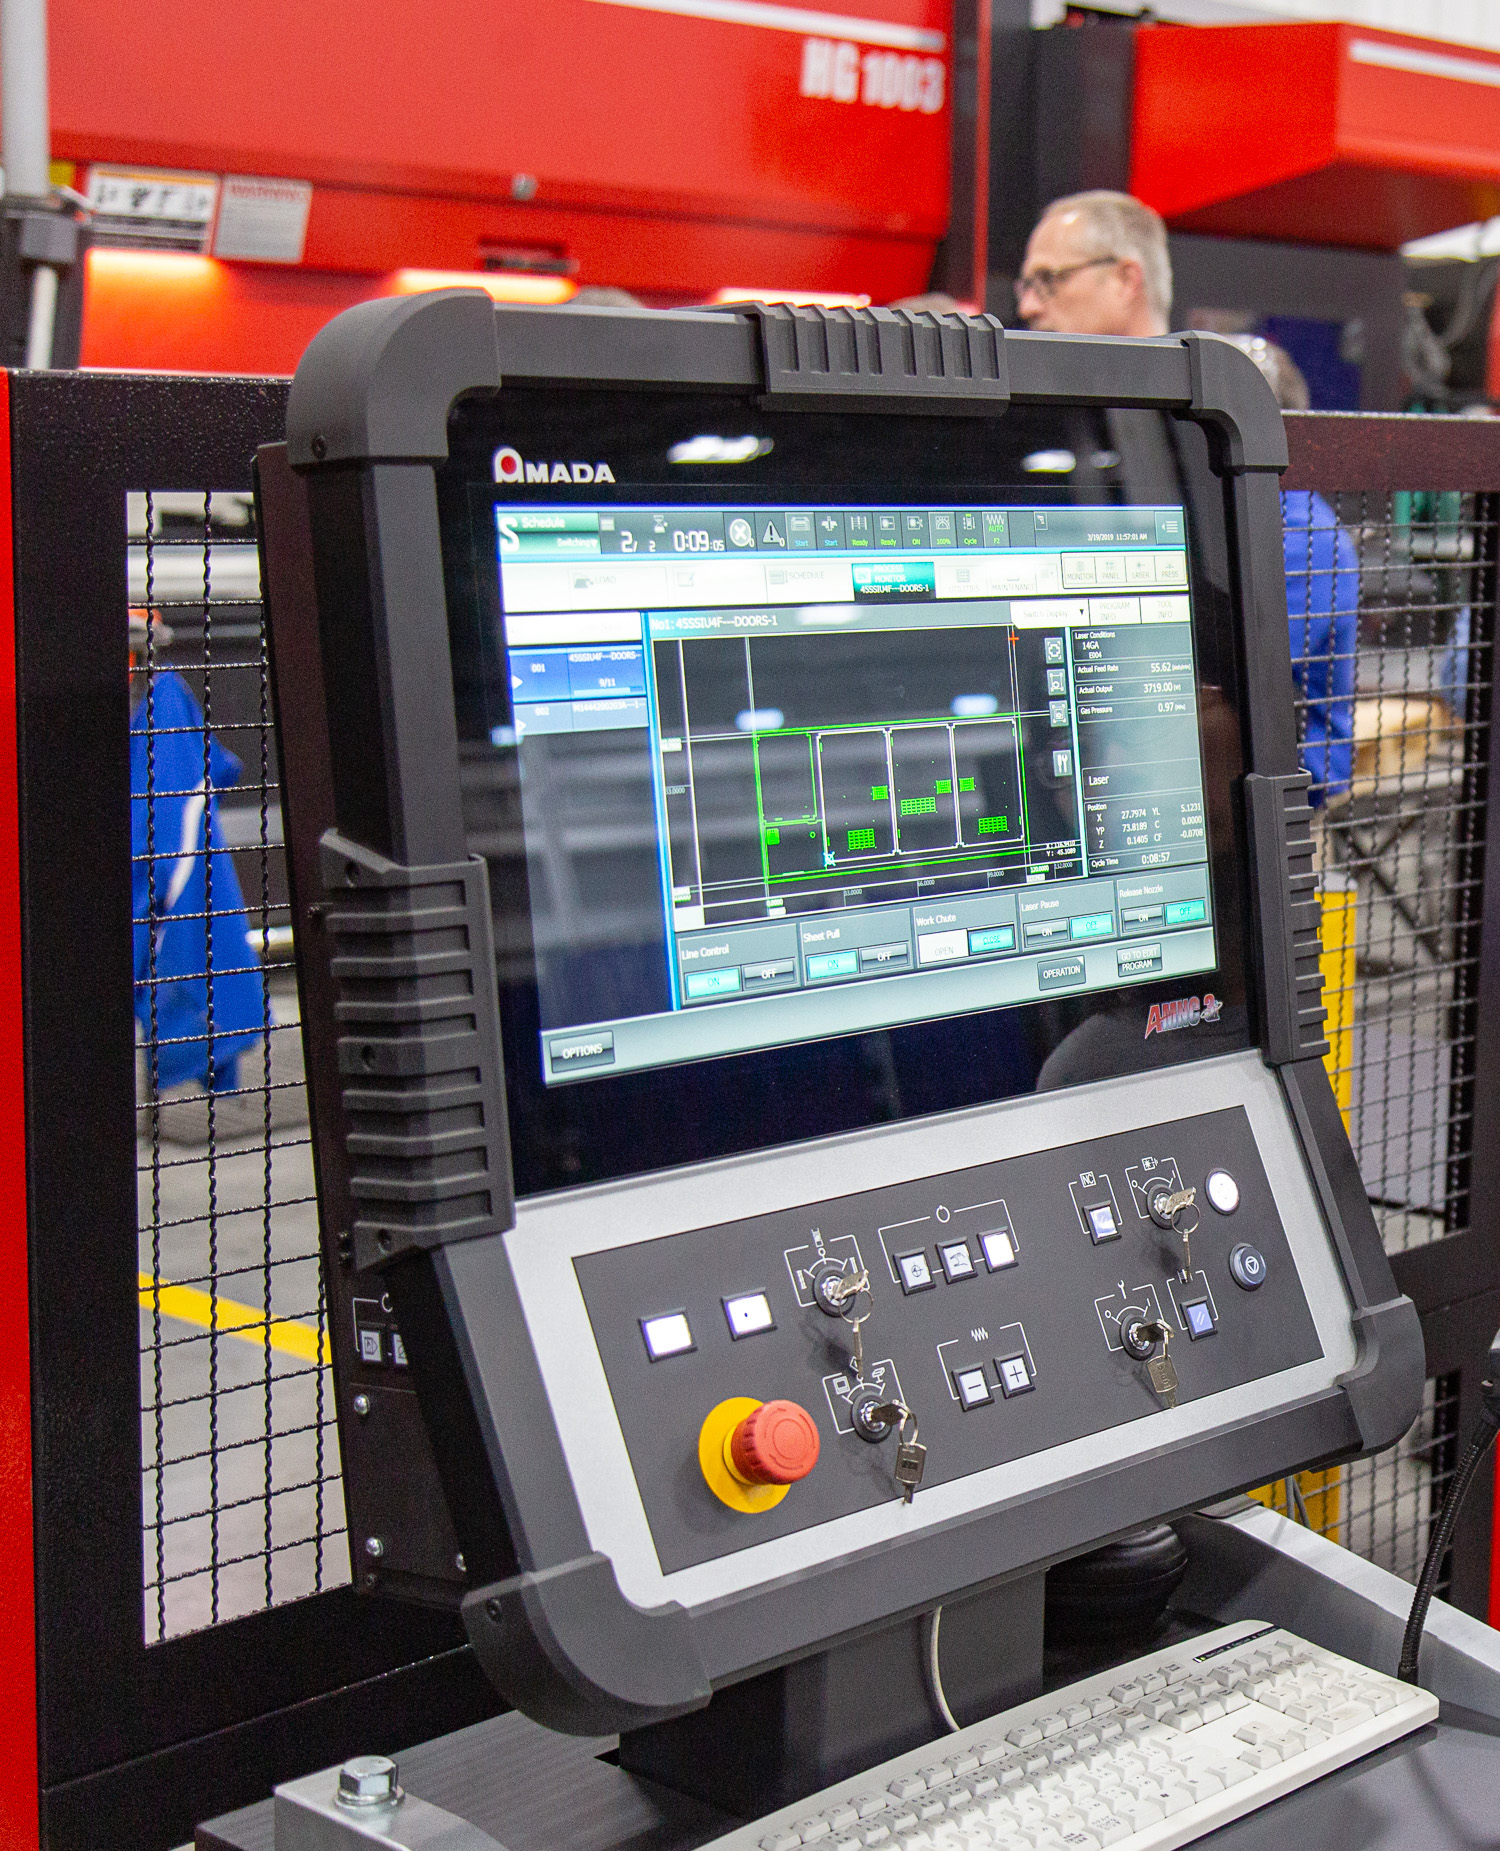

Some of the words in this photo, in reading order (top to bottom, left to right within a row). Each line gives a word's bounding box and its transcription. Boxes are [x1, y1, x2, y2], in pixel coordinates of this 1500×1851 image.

[803, 38, 859, 103] HG
[862, 53, 945, 114] 1003
[494, 447, 617, 484] AMADA
[521, 517, 566, 529] Schedule
[988, 524, 1004, 533] AUTO
[557, 537, 592, 548] Switching
[880, 538, 897, 547] Ready
[912, 538, 921, 546] ON
[1087, 533, 1113, 541] 3/19/2019
[1116, 533, 1138, 541] 11:57:01
[824, 539, 838, 547] Start
[851, 539, 869, 547] Ready
[874, 574, 906, 583] MONITOR
[1161, 570, 1179, 578] PRESS
[1074, 631, 1089, 640] Laser
[1090, 630, 1116, 639] Conditions
[1082, 641, 1100, 650] 14GA
[1077, 665, 1093, 674] Actual
[1094, 665, 1106, 673] Feed
[1107, 664, 1119, 672] Rate
[1150, 662, 1171, 673] 55.62
[599, 678, 616, 687] 9/11
[1143, 682, 1173, 693] 3719.00
[1079, 686, 1095, 694] Actual
[1095, 685, 1113, 694] Output
[1080, 707, 1091, 715] Gas
[1092, 706, 1113, 714] Pressure
[1157, 702, 1174, 712] 0.97
[1088, 776, 1109, 786] Laser
[1087, 803, 1107, 811] Position
[1096, 813, 1102, 822] X
[1121, 808, 1147, 820] 27.7974
[1152, 807, 1160, 816] YL
[1180, 803, 1201, 813] 5.1231
[1095, 827, 1105, 836] YP
[1154, 820, 1160, 829] C
[1181, 815, 1202, 825] 0.0000
[1098, 840, 1104, 849] Z
[1153, 833, 1162, 841] CF
[1091, 859, 1105, 868] Cycle
[1106, 858, 1119, 866] Time
[1141, 852, 1170, 864] 0:08:57
[1119, 887, 1143, 898] Release
[1144, 884, 1163, 896] Nozzle
[1021, 901, 1039, 912] Laser
[1040, 899, 1060, 910] Pause
[1179, 906, 1192, 916] OFF
[916, 916, 935, 927] Work
[936, 913, 957, 924] Chute
[1138, 912, 1149, 923] ON
[803, 932, 826, 943] Sheet
[826, 929, 841, 939] Pull
[1041, 927, 1053, 937] ON
[983, 935, 1001, 946] CLOSE
[681, 949, 699, 961] Line
[700, 944, 730, 958] Control
[877, 951, 892, 962] OFF
[935, 946, 954, 957] OPEN
[1121, 952, 1132, 961] GO
[1132, 950, 1142, 960] TO
[1142, 947, 1157, 958] EDIT
[827, 959, 839, 969] ON
[1121, 959, 1153, 972] PROGRAM
[761, 969, 777, 980] OFF
[1042, 965, 1081, 979] OPERATION
[707, 977, 720, 987] ON
[1144, 996, 1201, 1040] AMNC
[562, 1043, 603, 1060] OPTIONS
[1082, 1173, 1095, 1186] NC
